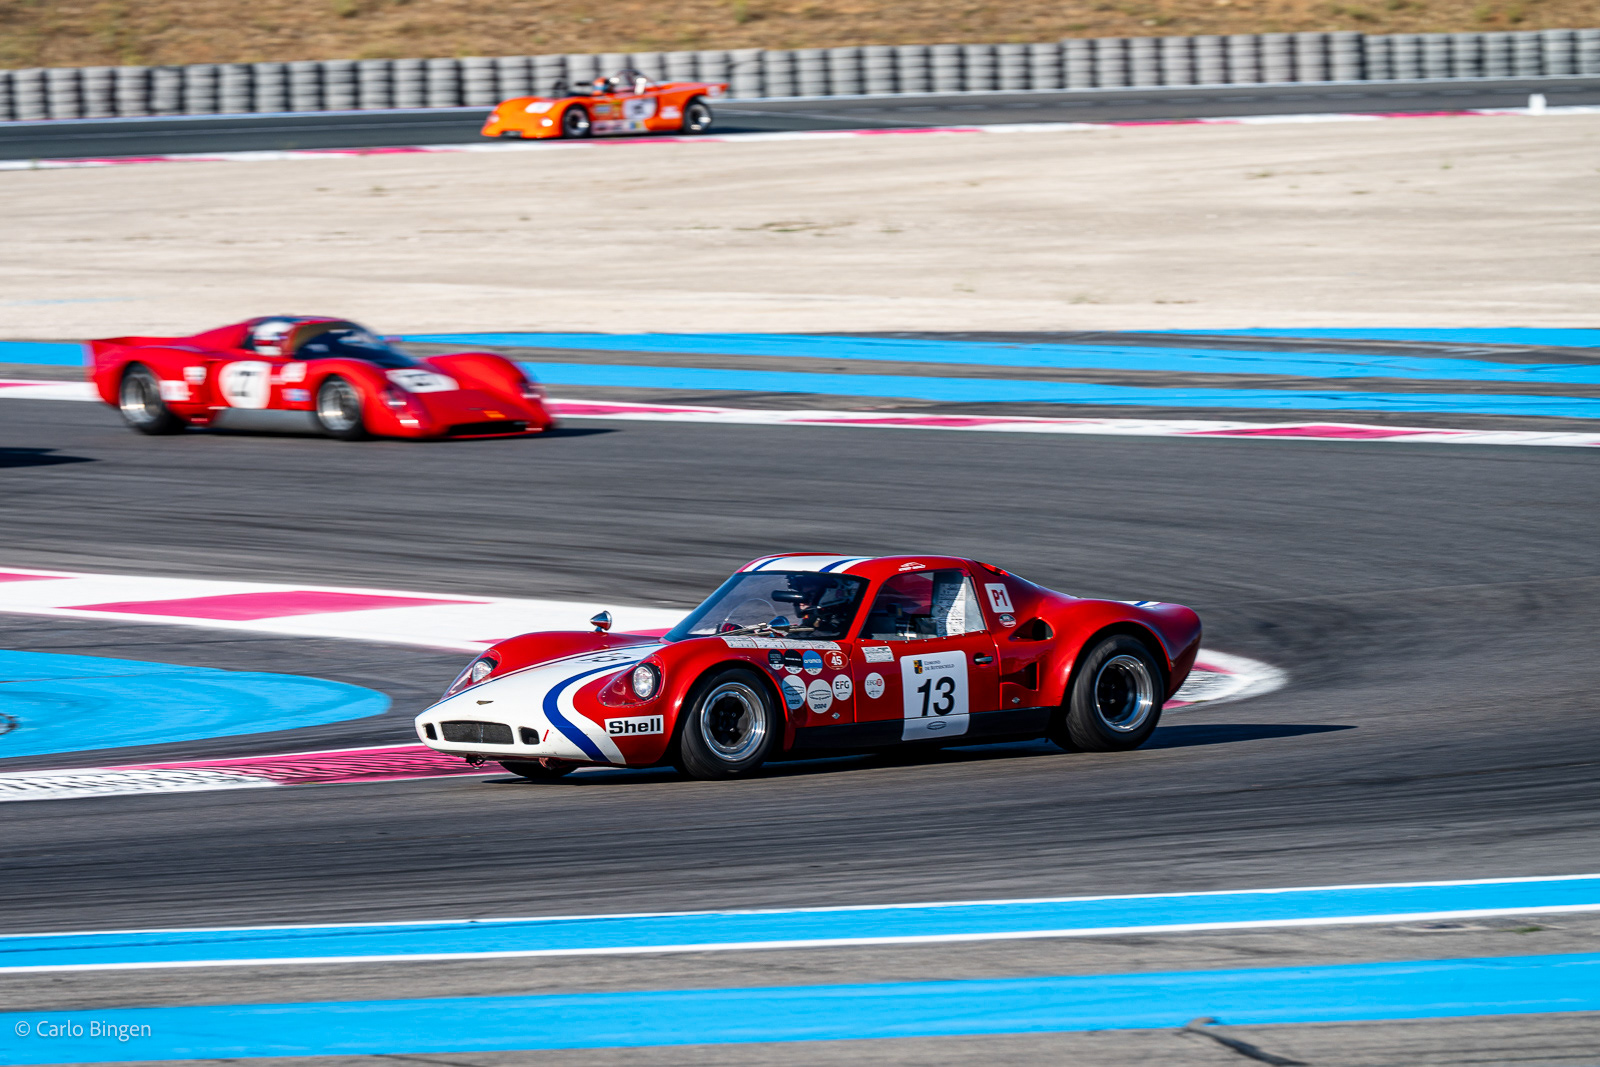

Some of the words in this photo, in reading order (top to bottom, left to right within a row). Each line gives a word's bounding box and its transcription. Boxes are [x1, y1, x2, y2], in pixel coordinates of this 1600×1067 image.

[990, 589, 1009, 607] P1
[831, 655, 843, 666] 45
[835, 680, 850, 690] EFG
[917, 676, 955, 717] 13
[608, 718, 661, 735] Shell
